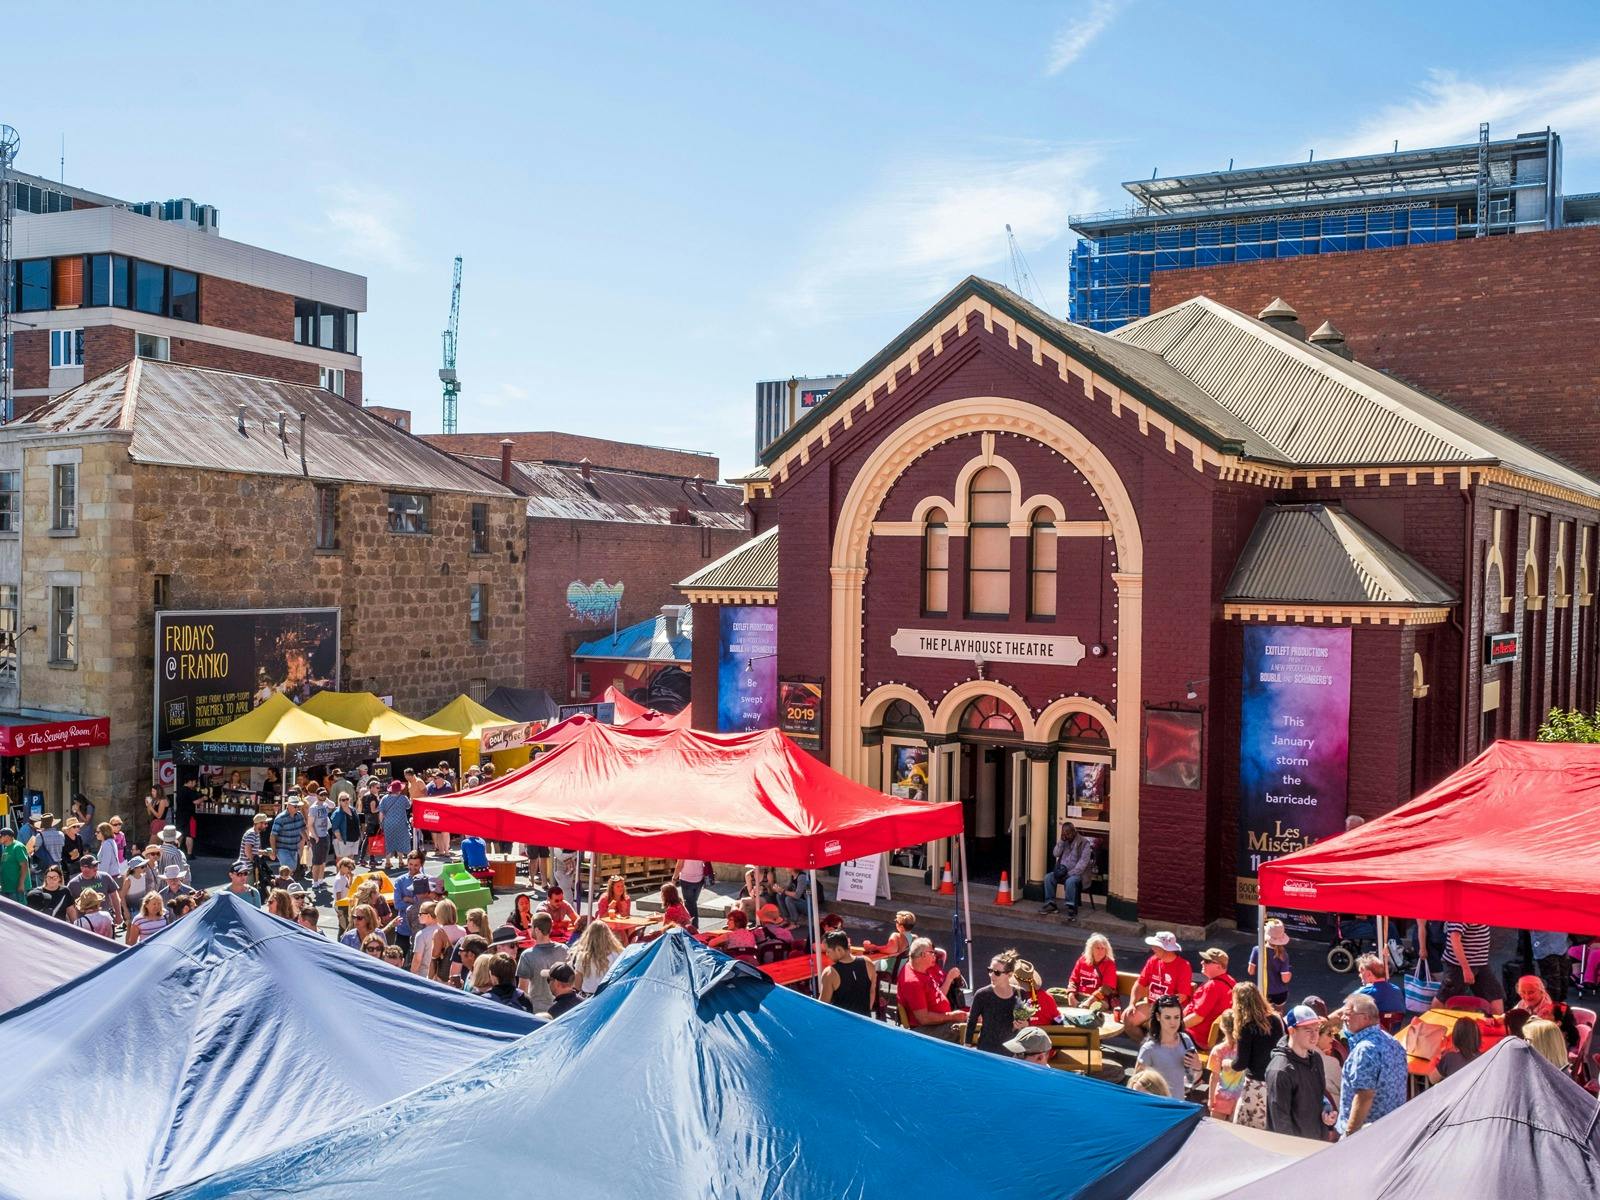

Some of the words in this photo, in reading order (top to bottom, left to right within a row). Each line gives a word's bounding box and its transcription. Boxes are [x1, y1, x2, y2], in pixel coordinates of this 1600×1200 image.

[816, 392, 831, 402] na
[166, 624, 214, 652] FRIDAYS
[919, 637, 939, 651] THE
[941, 638, 1002, 654] PLAYHOUSE
[1005, 641, 1054, 657] THEATRE
[1265, 645, 1290, 656] EXITLEFT
[1290, 646, 1329, 657] PRODUCTIONS
[165, 656, 177, 680] @
[181, 652, 229, 680] FRANKO
[747, 678, 757, 687] Be
[741, 697, 763, 705] swept
[195, 703, 224, 717] NOVEMBER
[226, 702, 234, 714] TO
[235, 701, 249, 714] APRIL
[787, 707, 815, 720] 2019
[743, 711, 761, 721] away
[1282, 716, 1304, 727] This
[28, 732, 44, 745] The
[44, 729, 69, 743] Sewing
[69, 725, 91, 738] Room
[202, 741, 229, 753] breakfast
[229, 743, 248, 752] brunch
[253, 743, 272, 753] coffee
[1271, 735, 1315, 750] January
[1276, 755, 1309, 767] storm
[374, 768, 388, 776] MENU
[1282, 774, 1302, 786] the
[1265, 792, 1318, 806] barricade
[1275, 820, 1300, 839] Les
[1248, 830, 1318, 853] Misérab
